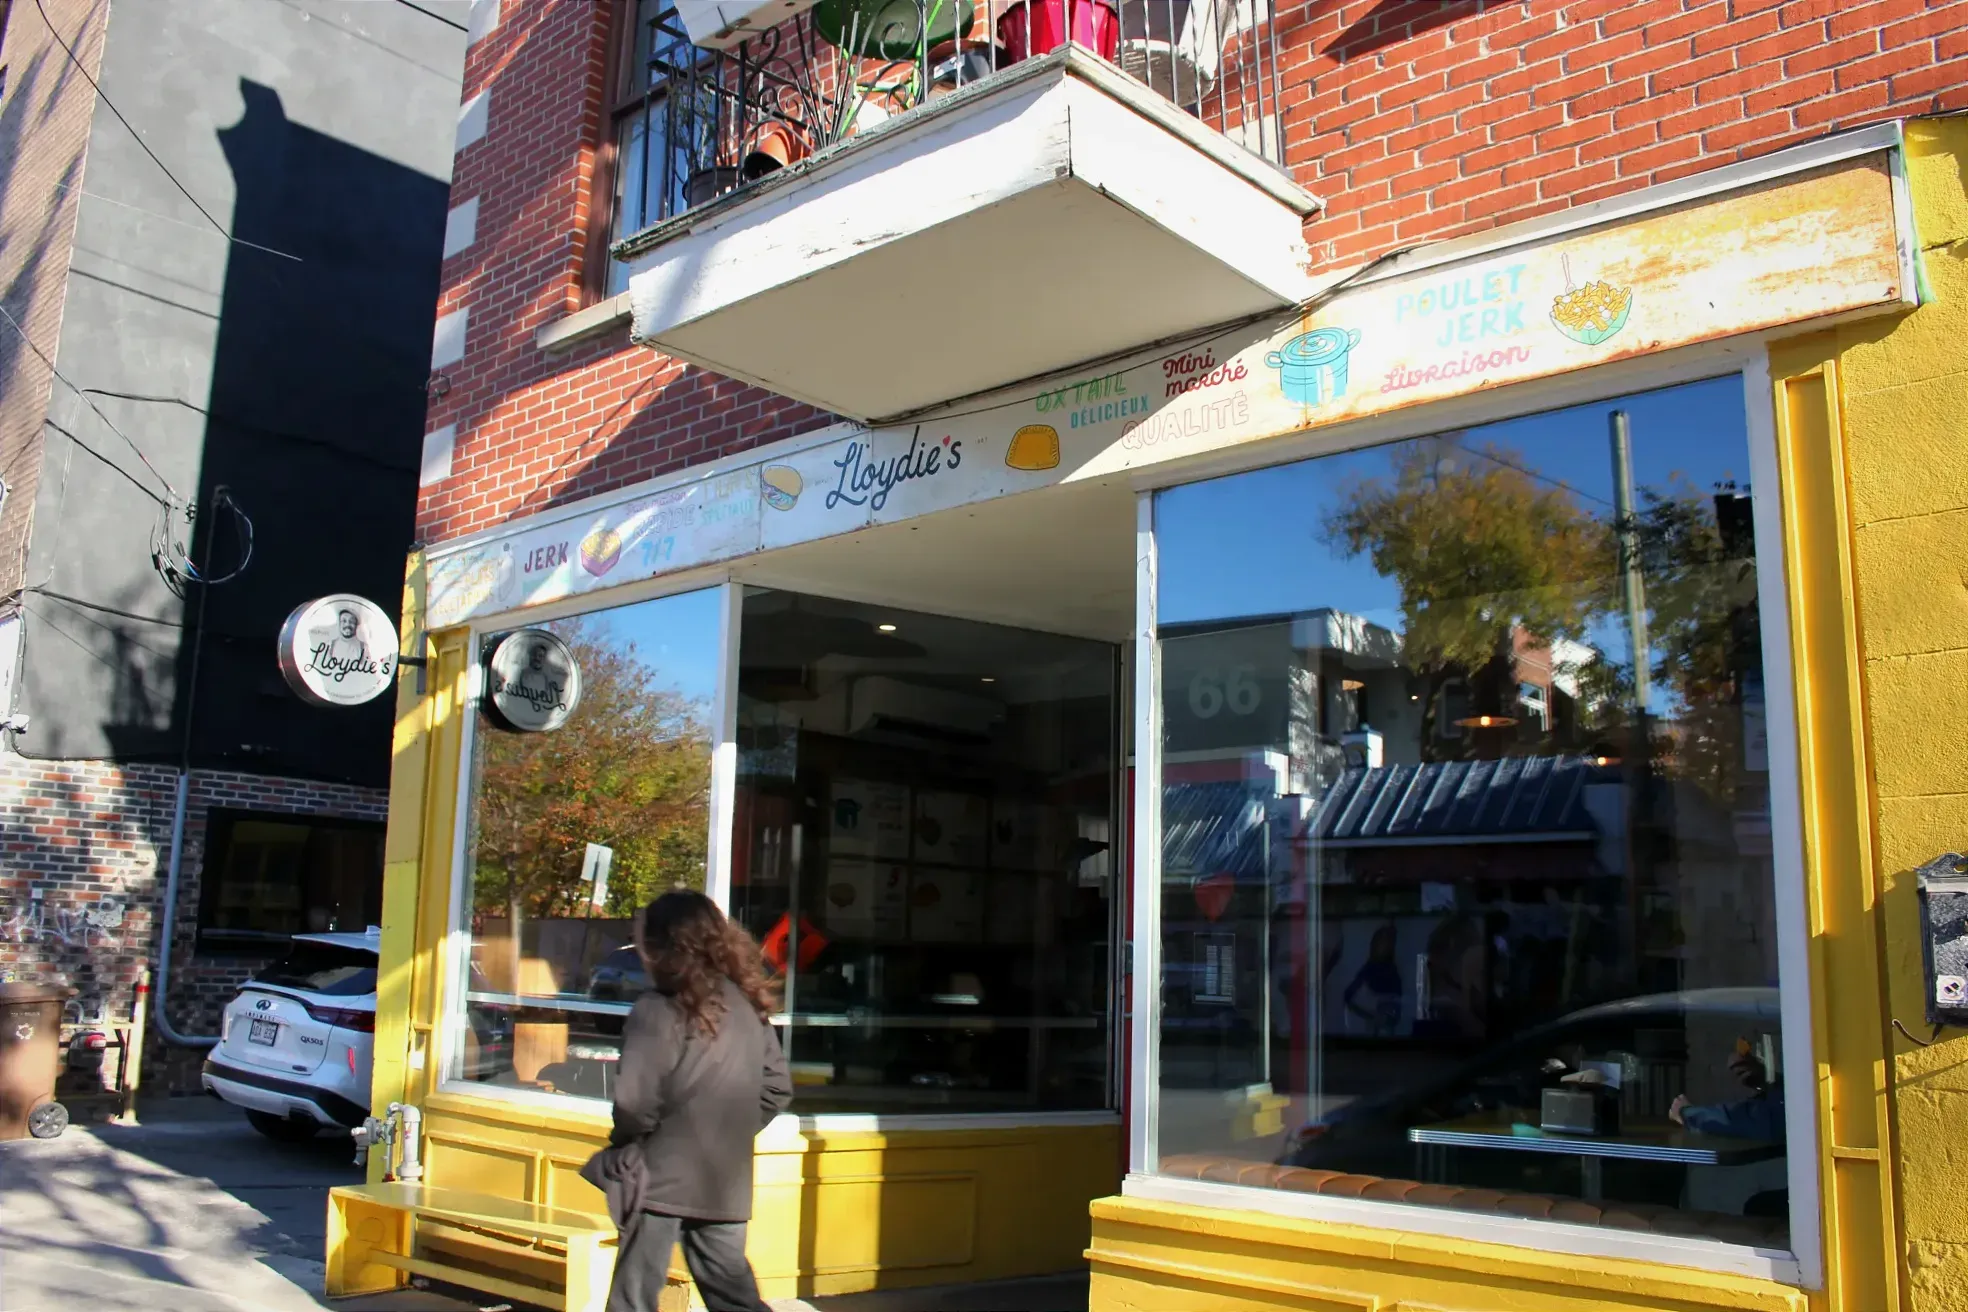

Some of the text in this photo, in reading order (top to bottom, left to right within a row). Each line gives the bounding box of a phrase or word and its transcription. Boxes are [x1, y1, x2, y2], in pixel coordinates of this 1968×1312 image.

[1396, 264, 1527, 325] POULET
[1437, 301, 1525, 348] JERK
[1162, 347, 1216, 379] Mini
[1164, 358, 1249, 398] marché
[1380, 345, 1531, 395] Livraison
[1070, 393, 1150, 429] DÉLICIEUX
[1121, 389, 1250, 451] QUALITÉ
[825, 424, 963, 512] Lloydie's
[524, 541, 569, 573] JERK
[640, 537, 676, 568] 7/7
[304, 641, 391, 683] Lloydie's
[1188, 661, 1263, 720] 66
